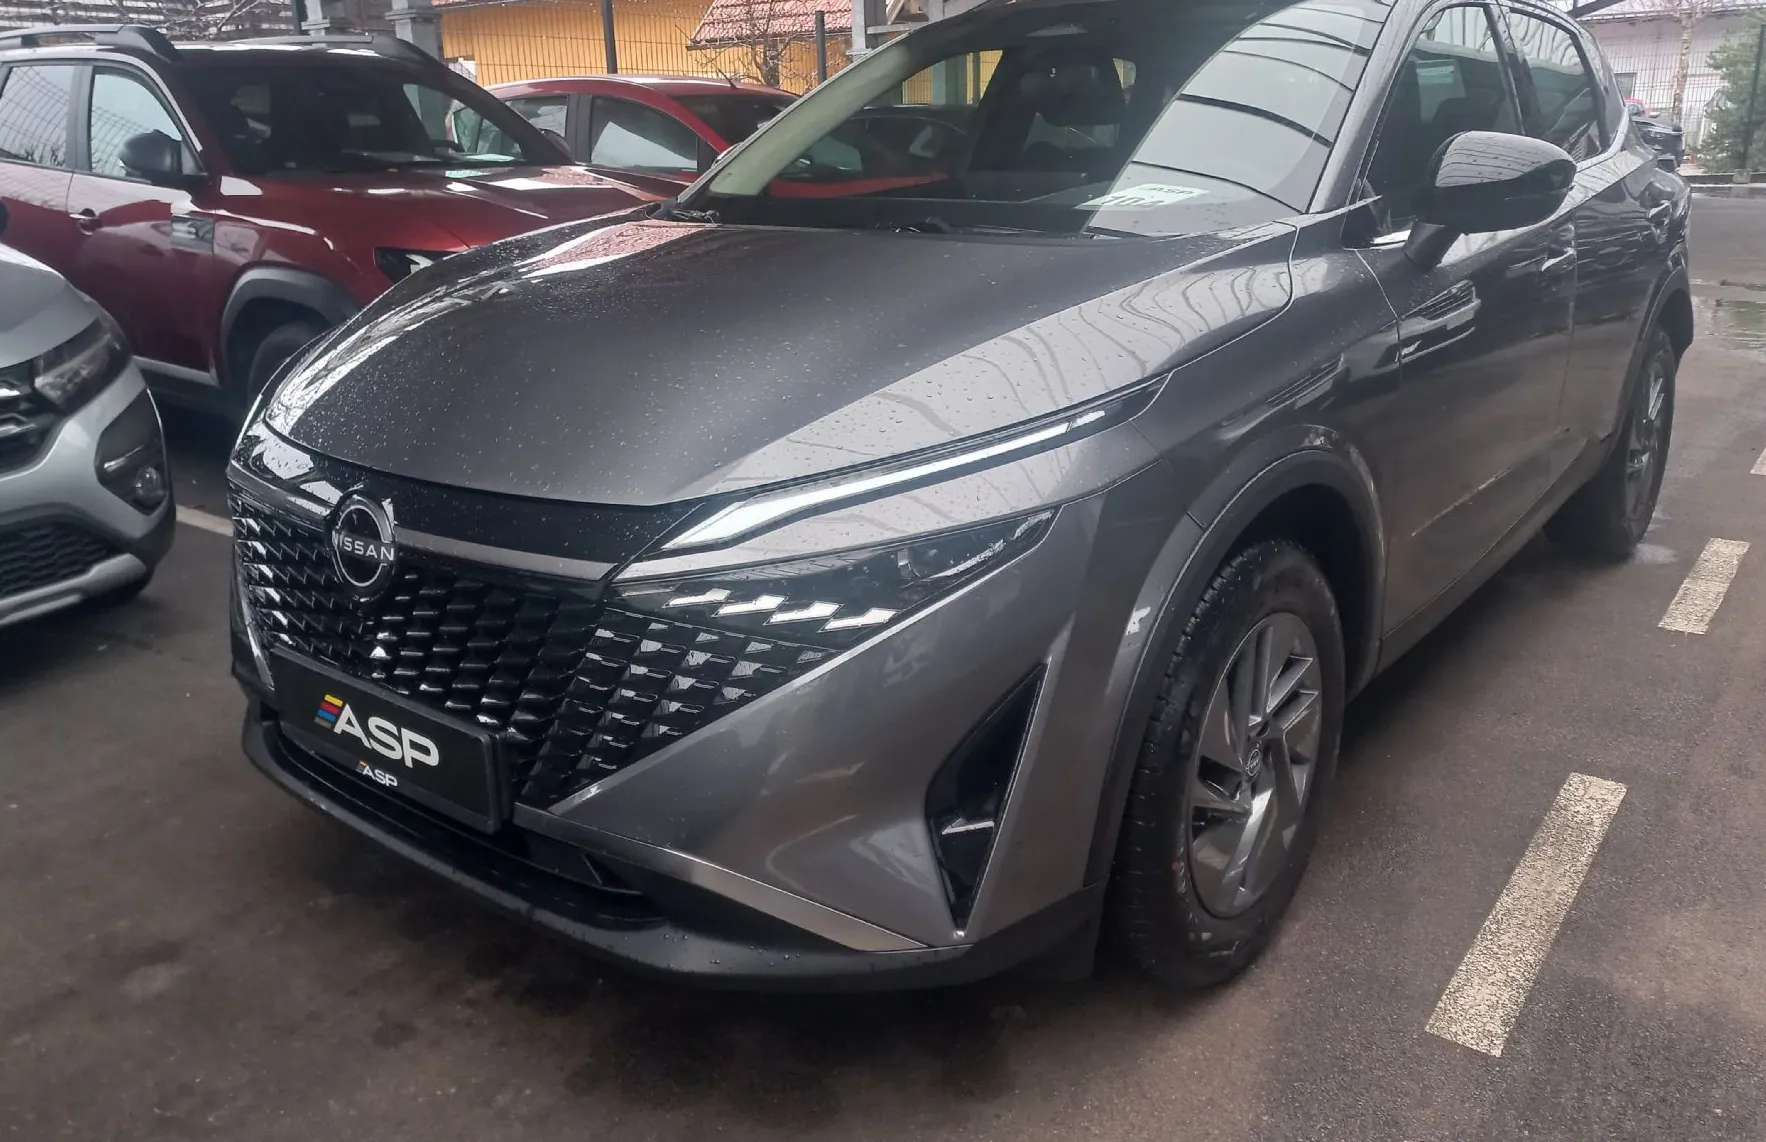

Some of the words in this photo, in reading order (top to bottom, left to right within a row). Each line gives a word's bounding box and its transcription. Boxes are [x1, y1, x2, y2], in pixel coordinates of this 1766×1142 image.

[332, 531, 395, 561] NISSAN
[333, 703, 440, 768] ASP
[362, 765, 398, 787] ASP
